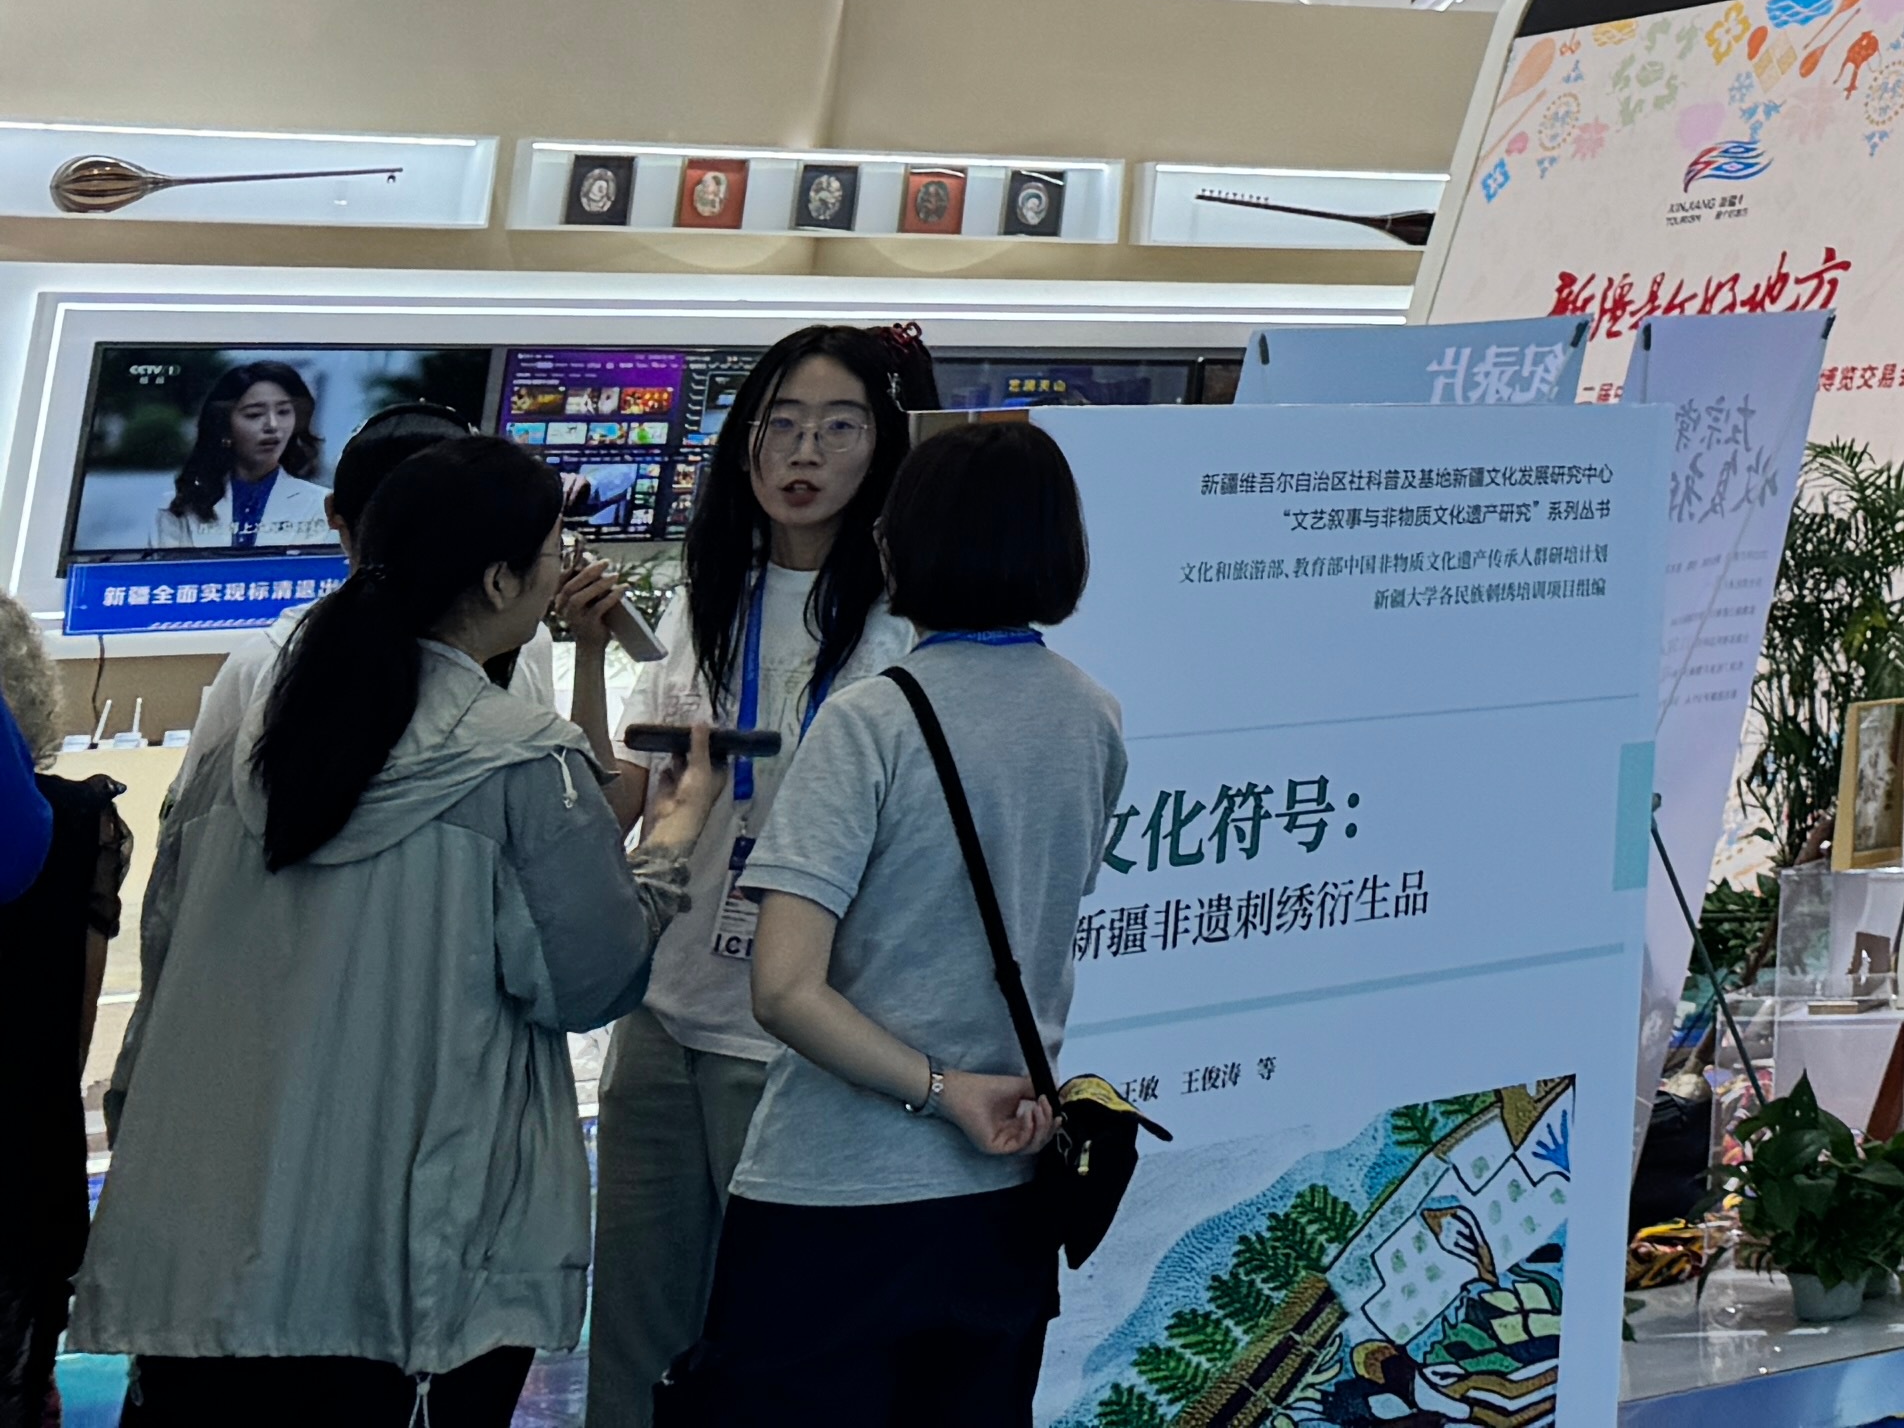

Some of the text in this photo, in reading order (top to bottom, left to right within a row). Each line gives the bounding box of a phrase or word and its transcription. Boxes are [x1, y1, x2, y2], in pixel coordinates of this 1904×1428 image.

[1200, 464, 1615, 496] 新疆维吾尔自治区社科普及基地新疆文化发展研究中心
[1072, 870, 1430, 962] 新疆非遗刺绣衍生品
[1180, 1061, 1242, 1096] 王俊涛
[1257, 1056, 1277, 1081] 等
